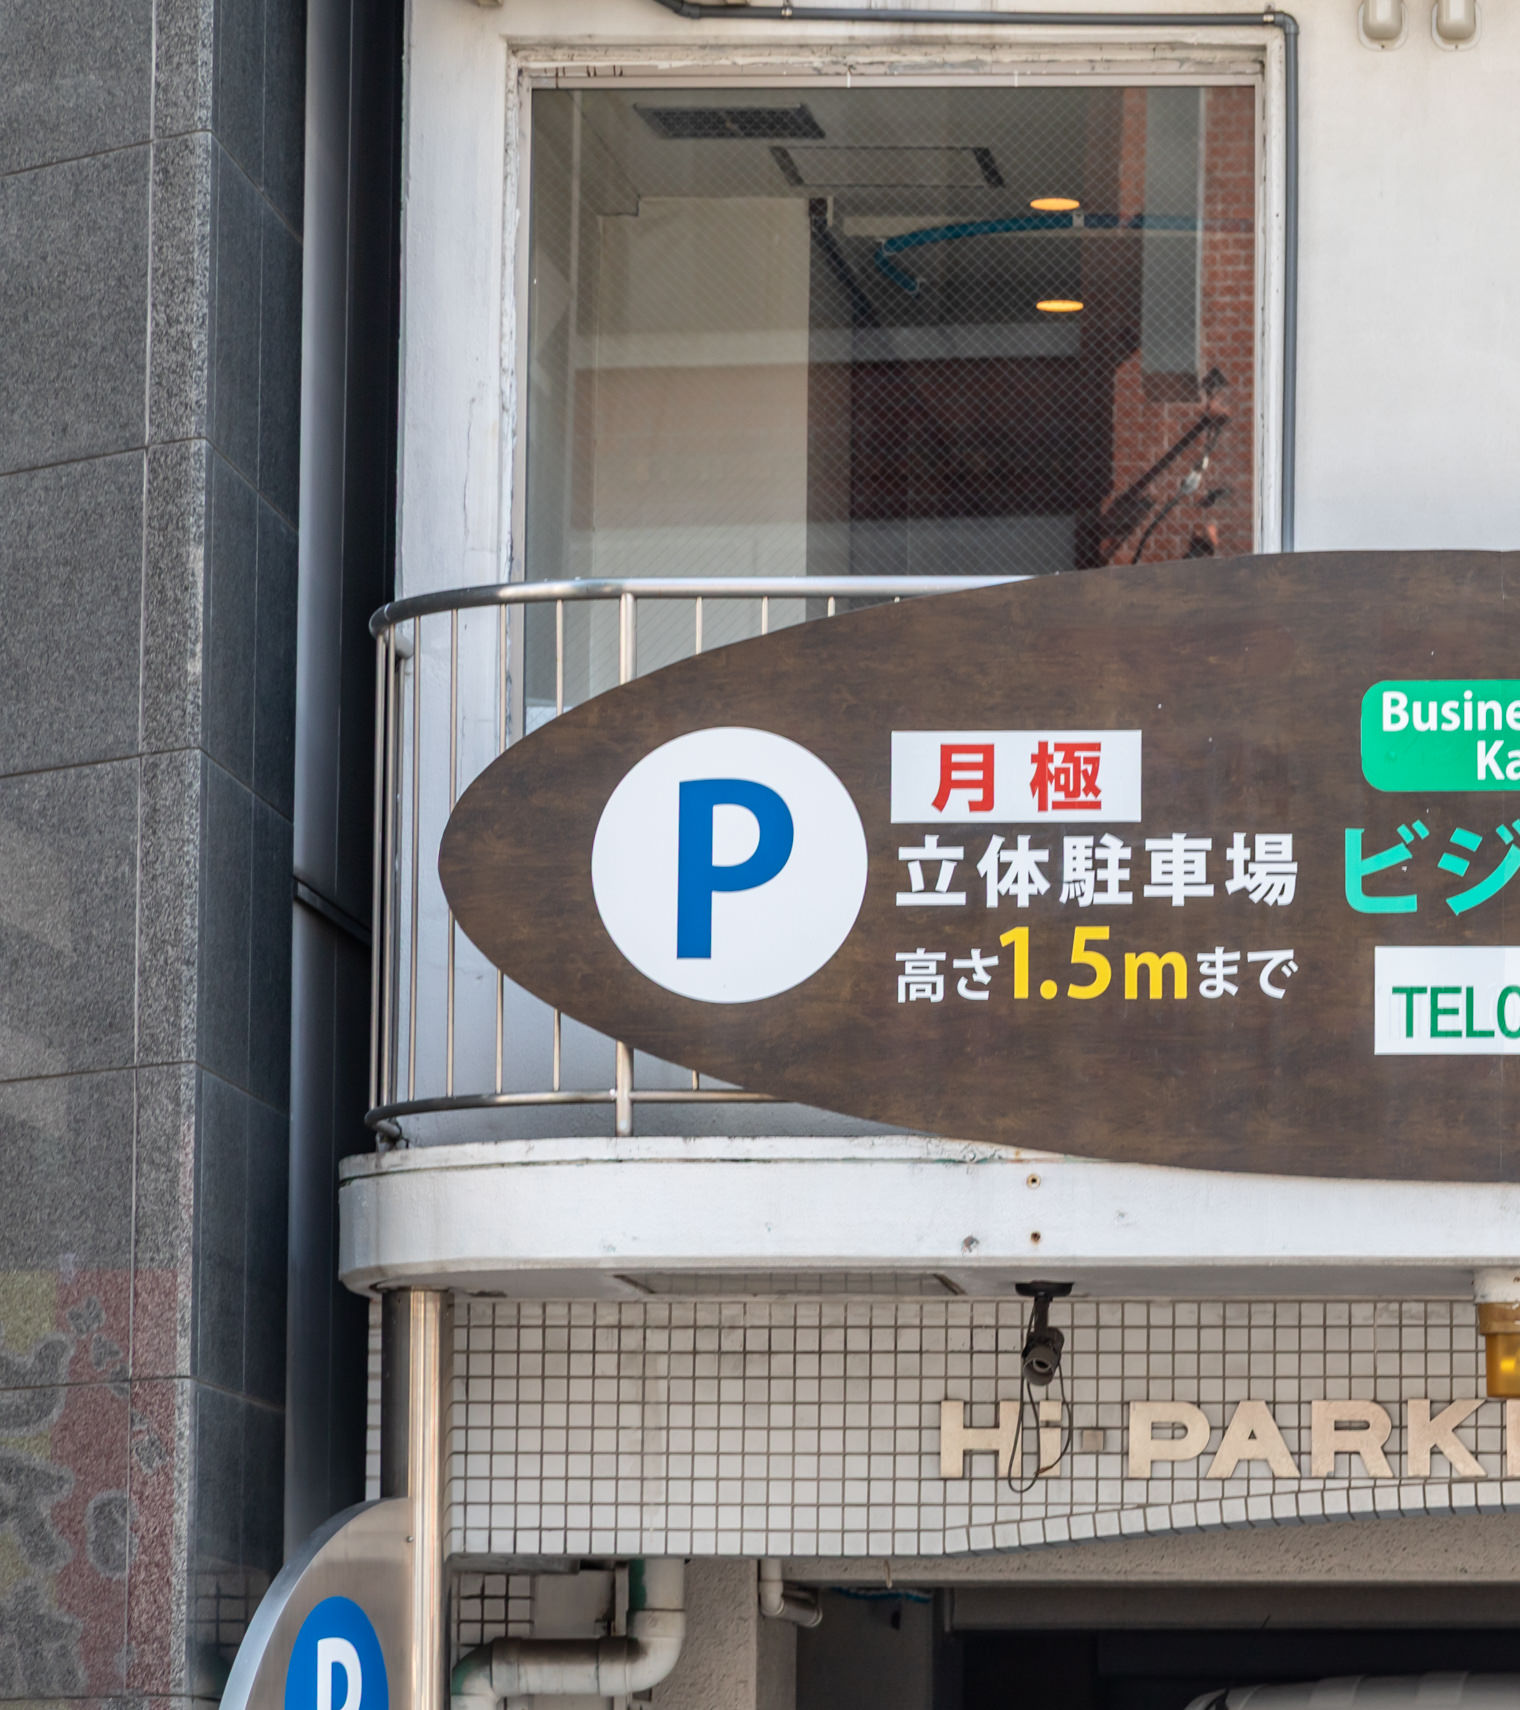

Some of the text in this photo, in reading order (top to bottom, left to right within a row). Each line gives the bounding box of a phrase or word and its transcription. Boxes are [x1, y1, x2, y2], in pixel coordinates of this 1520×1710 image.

[931, 740, 1102, 813] 月極
[676, 778, 795, 960] P
[895, 831, 1298, 908] 立体駐車場
